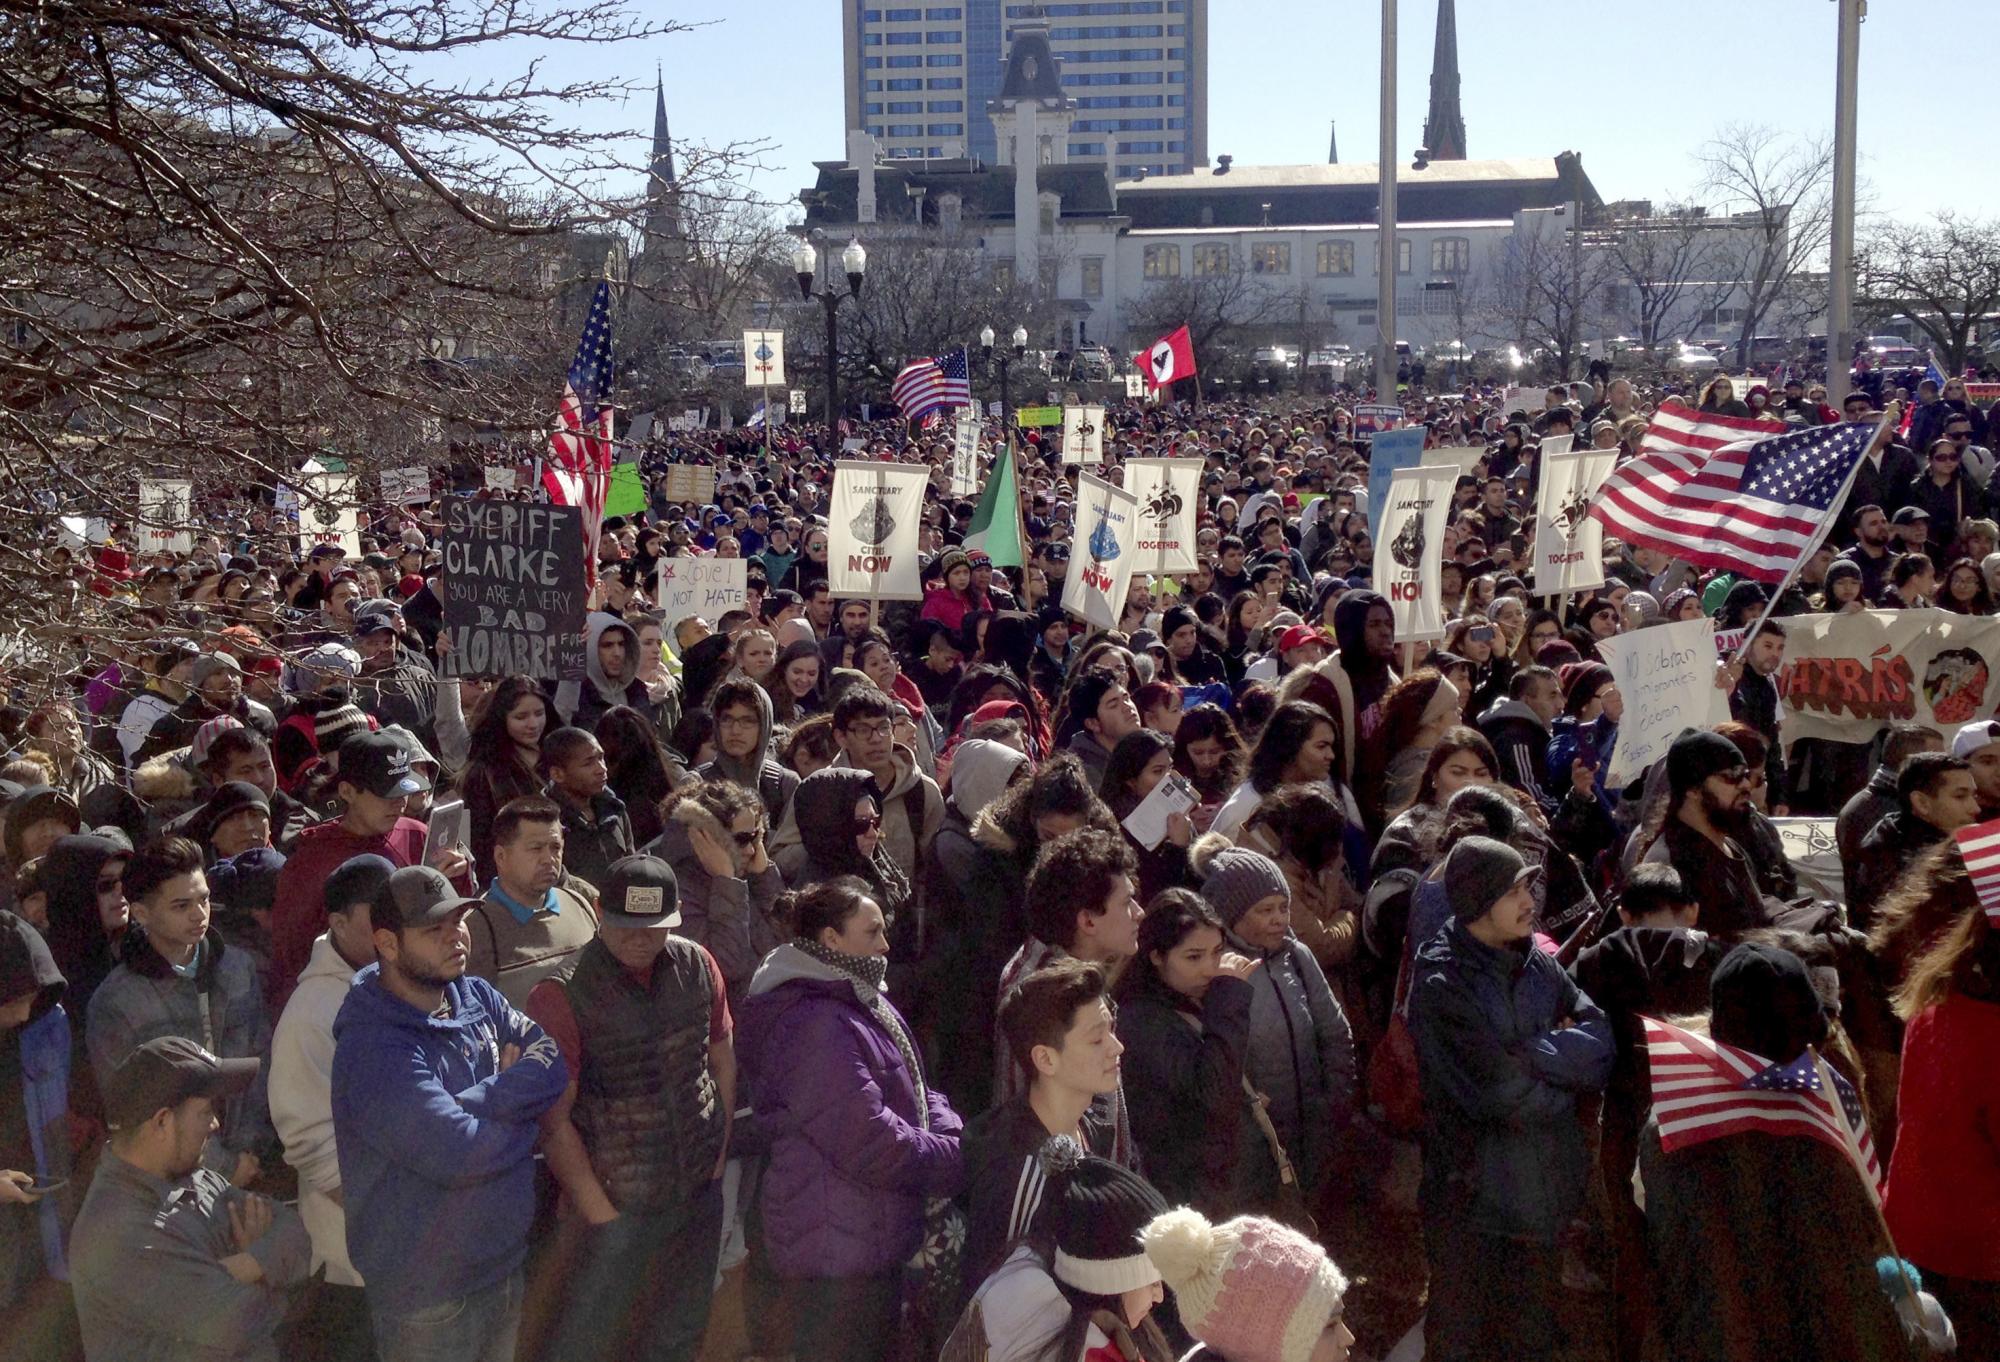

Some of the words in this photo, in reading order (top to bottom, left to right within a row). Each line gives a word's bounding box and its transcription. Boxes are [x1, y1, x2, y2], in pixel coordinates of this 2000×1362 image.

[754, 364, 774, 372] NOW
[852, 486, 903, 495] SANCTUARY
[150, 530, 176, 539] NOW
[448, 502, 568, 550] SHERIFF
[314, 533, 342, 543] NOW
[1137, 541, 1180, 550] TOGETHER
[446, 541, 560, 586] CLARKE
[847, 555, 893, 573] NOW
[1081, 567, 1114, 593] NOW
[449, 581, 478, 603] YOU
[486, 584, 513, 608] ARE
[516, 587, 528, 608] A
[535, 589, 572, 615] VERY
[671, 590, 694, 609] NOT
[704, 588, 743, 608] HATE
[475, 605, 547, 632] BAD
[447, 625, 558, 681] HOMBRE
[561, 651, 585, 668] MKE
